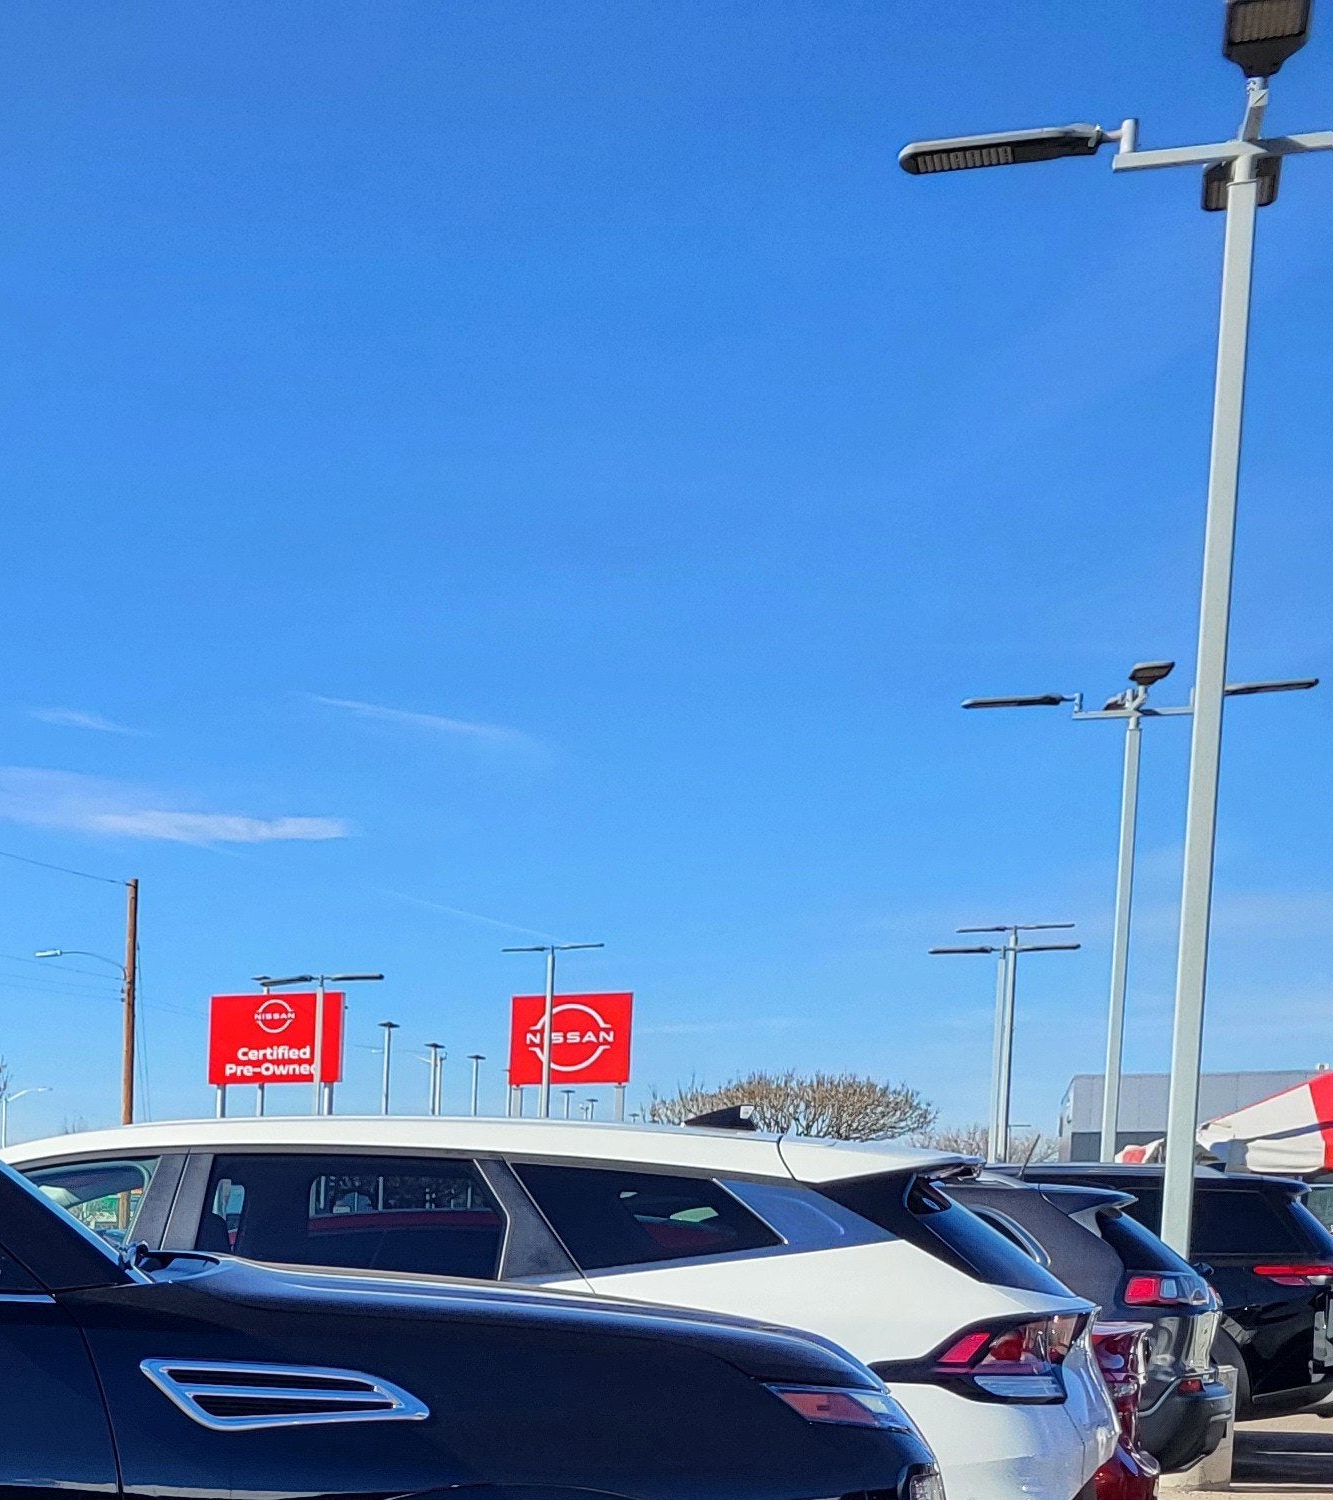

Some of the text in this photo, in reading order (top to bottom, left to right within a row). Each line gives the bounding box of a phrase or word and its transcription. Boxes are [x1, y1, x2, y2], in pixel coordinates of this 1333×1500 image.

[254, 1012, 295, 1020] NISSAN
[526, 1030, 614, 1045] NSSAN
[237, 1045, 311, 1061] Certified
